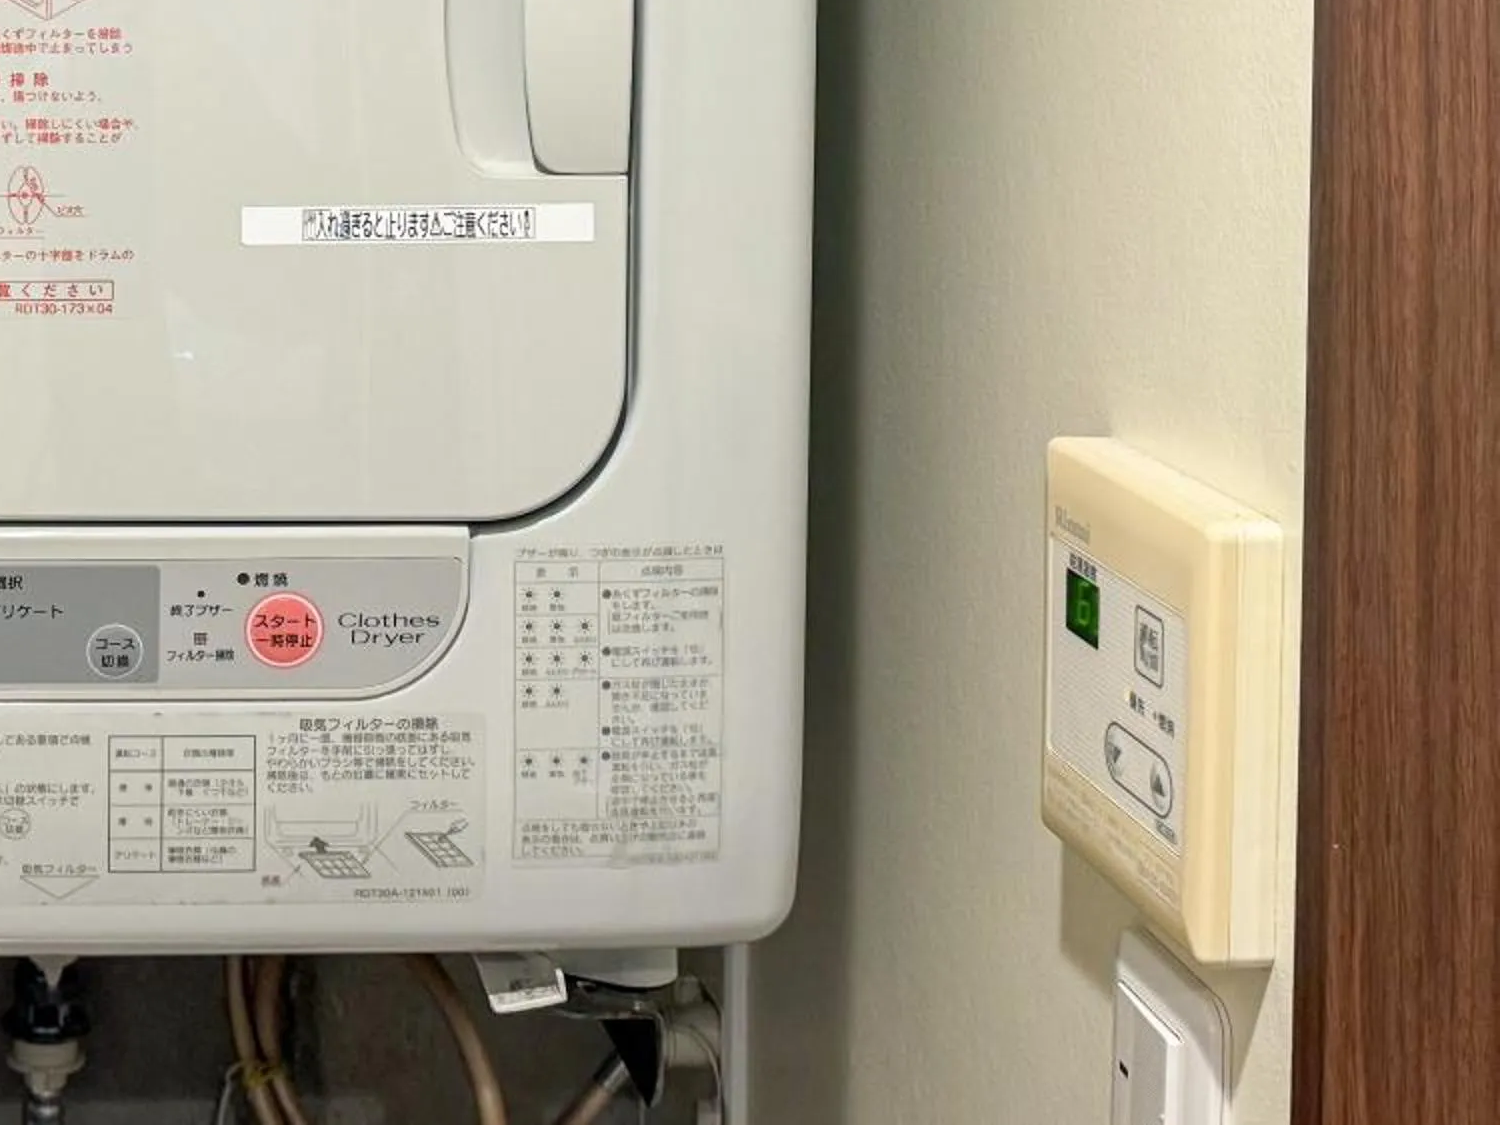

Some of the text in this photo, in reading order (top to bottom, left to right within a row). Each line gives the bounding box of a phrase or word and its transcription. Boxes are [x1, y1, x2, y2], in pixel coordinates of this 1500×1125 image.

[170, 605, 233, 617] 終了ブザー
[254, 613, 317, 628] スタート
[338, 611, 440, 629] Clothes
[95, 638, 136, 650] コース
[255, 634, 313, 648] 一時停止
[350, 629, 425, 646] Dryer
[101, 655, 129, 669] 切換
